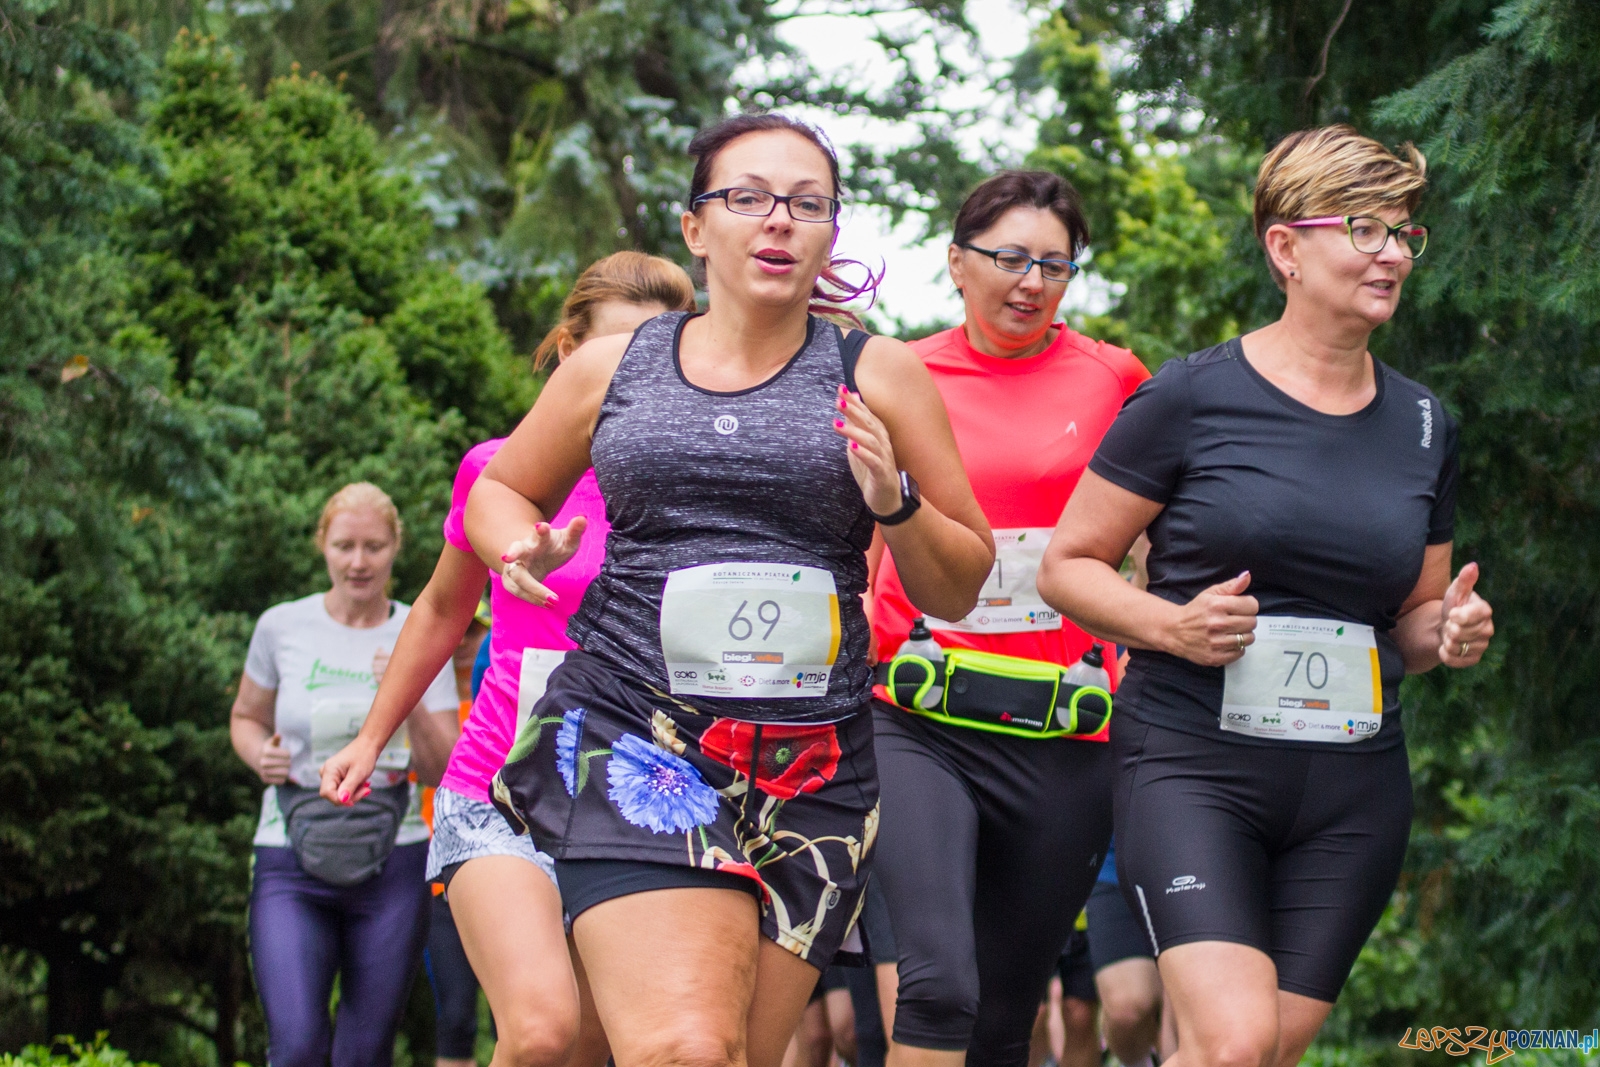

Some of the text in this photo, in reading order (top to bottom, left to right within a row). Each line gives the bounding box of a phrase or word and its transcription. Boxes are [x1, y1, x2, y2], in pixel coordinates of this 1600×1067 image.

[1421, 409, 1433, 449] Reebok
[728, 599, 781, 641] 69
[674, 670, 698, 679] GOKO
[1283, 650, 1329, 690] 70
[805, 672, 827, 684] mjp
[1227, 712, 1252, 722] GOKO
[1357, 720, 1379, 732] mjp
